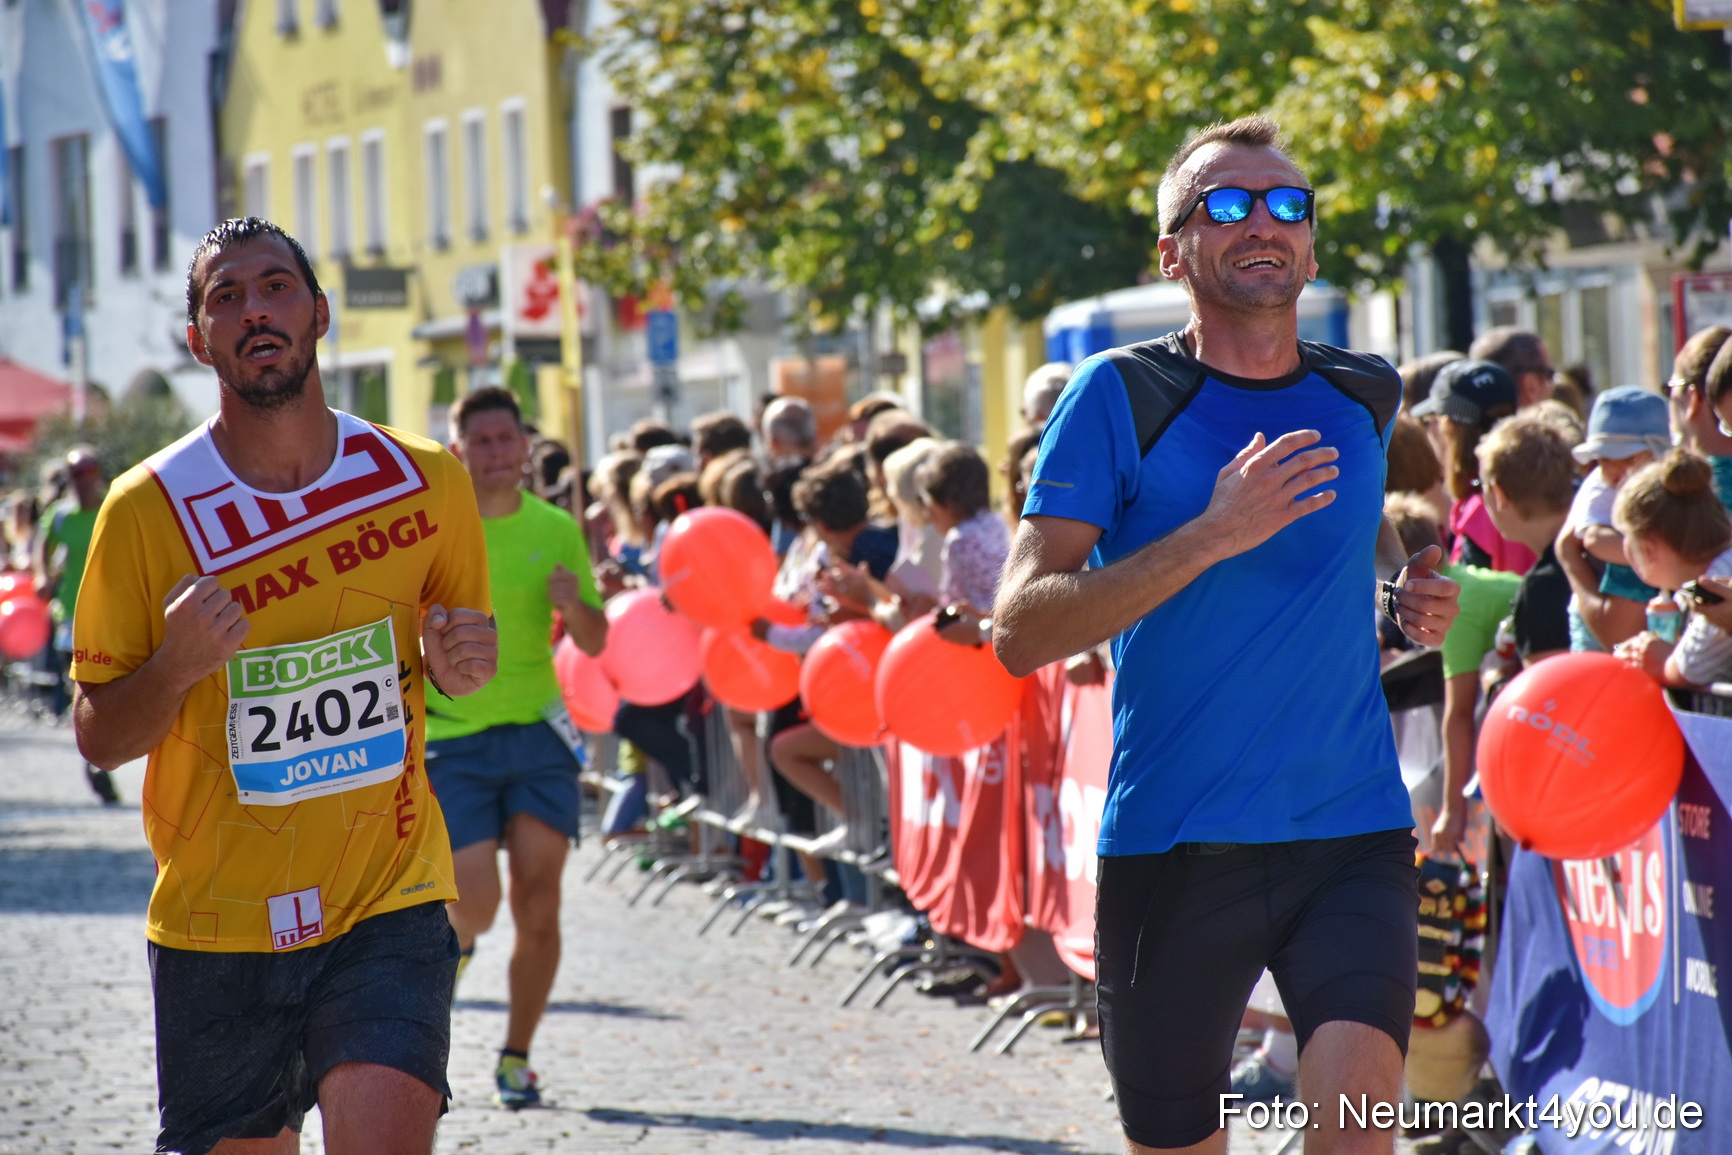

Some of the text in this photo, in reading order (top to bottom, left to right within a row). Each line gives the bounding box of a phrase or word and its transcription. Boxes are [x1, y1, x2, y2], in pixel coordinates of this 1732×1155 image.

[326, 509, 438, 576] BÖGL
[74, 648, 112, 666] gl.de
[243, 630, 382, 691] BOCK
[248, 680, 385, 753] 2402
[279, 747, 369, 786] JOVAN
[1678, 803, 1711, 840] STORE
[1682, 880, 1715, 920] ONLINE
[1685, 957, 1718, 999] MOBILE
